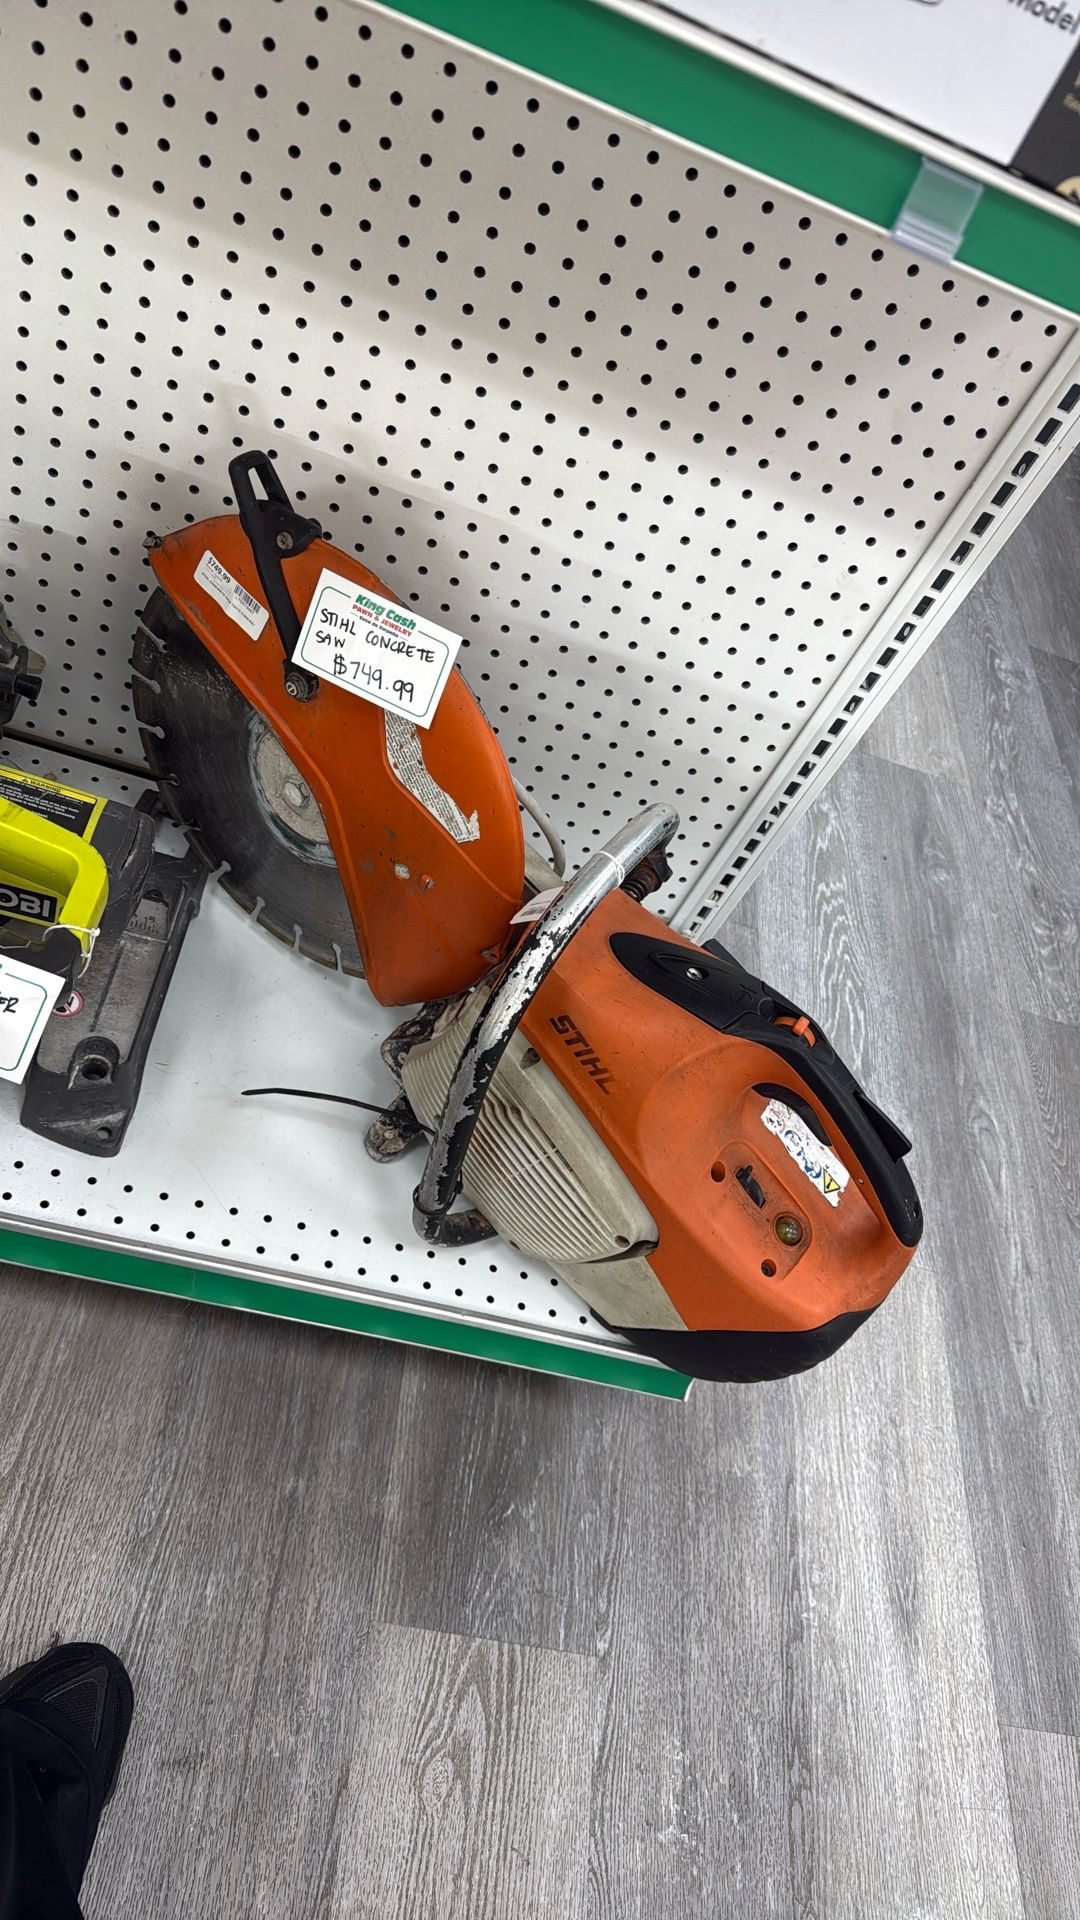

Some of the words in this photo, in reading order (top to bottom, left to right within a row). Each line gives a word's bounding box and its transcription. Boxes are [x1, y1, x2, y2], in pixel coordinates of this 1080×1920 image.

[207, 556, 231, 584] $749.99
[352, 604, 374, 618] PAWN
[380, 618, 413, 637] JEWELRY
[354, 594, 386, 617] King
[386, 609, 417, 631] Cash
[315, 630, 346, 648] SAW
[320, 608, 356, 636] STIHL
[365, 630, 436, 663] CONCRETE
[333, 653, 415, 703] $749.99
[30, 779, 61, 793] WARNING
[548, 1014, 613, 1096] STIHL
